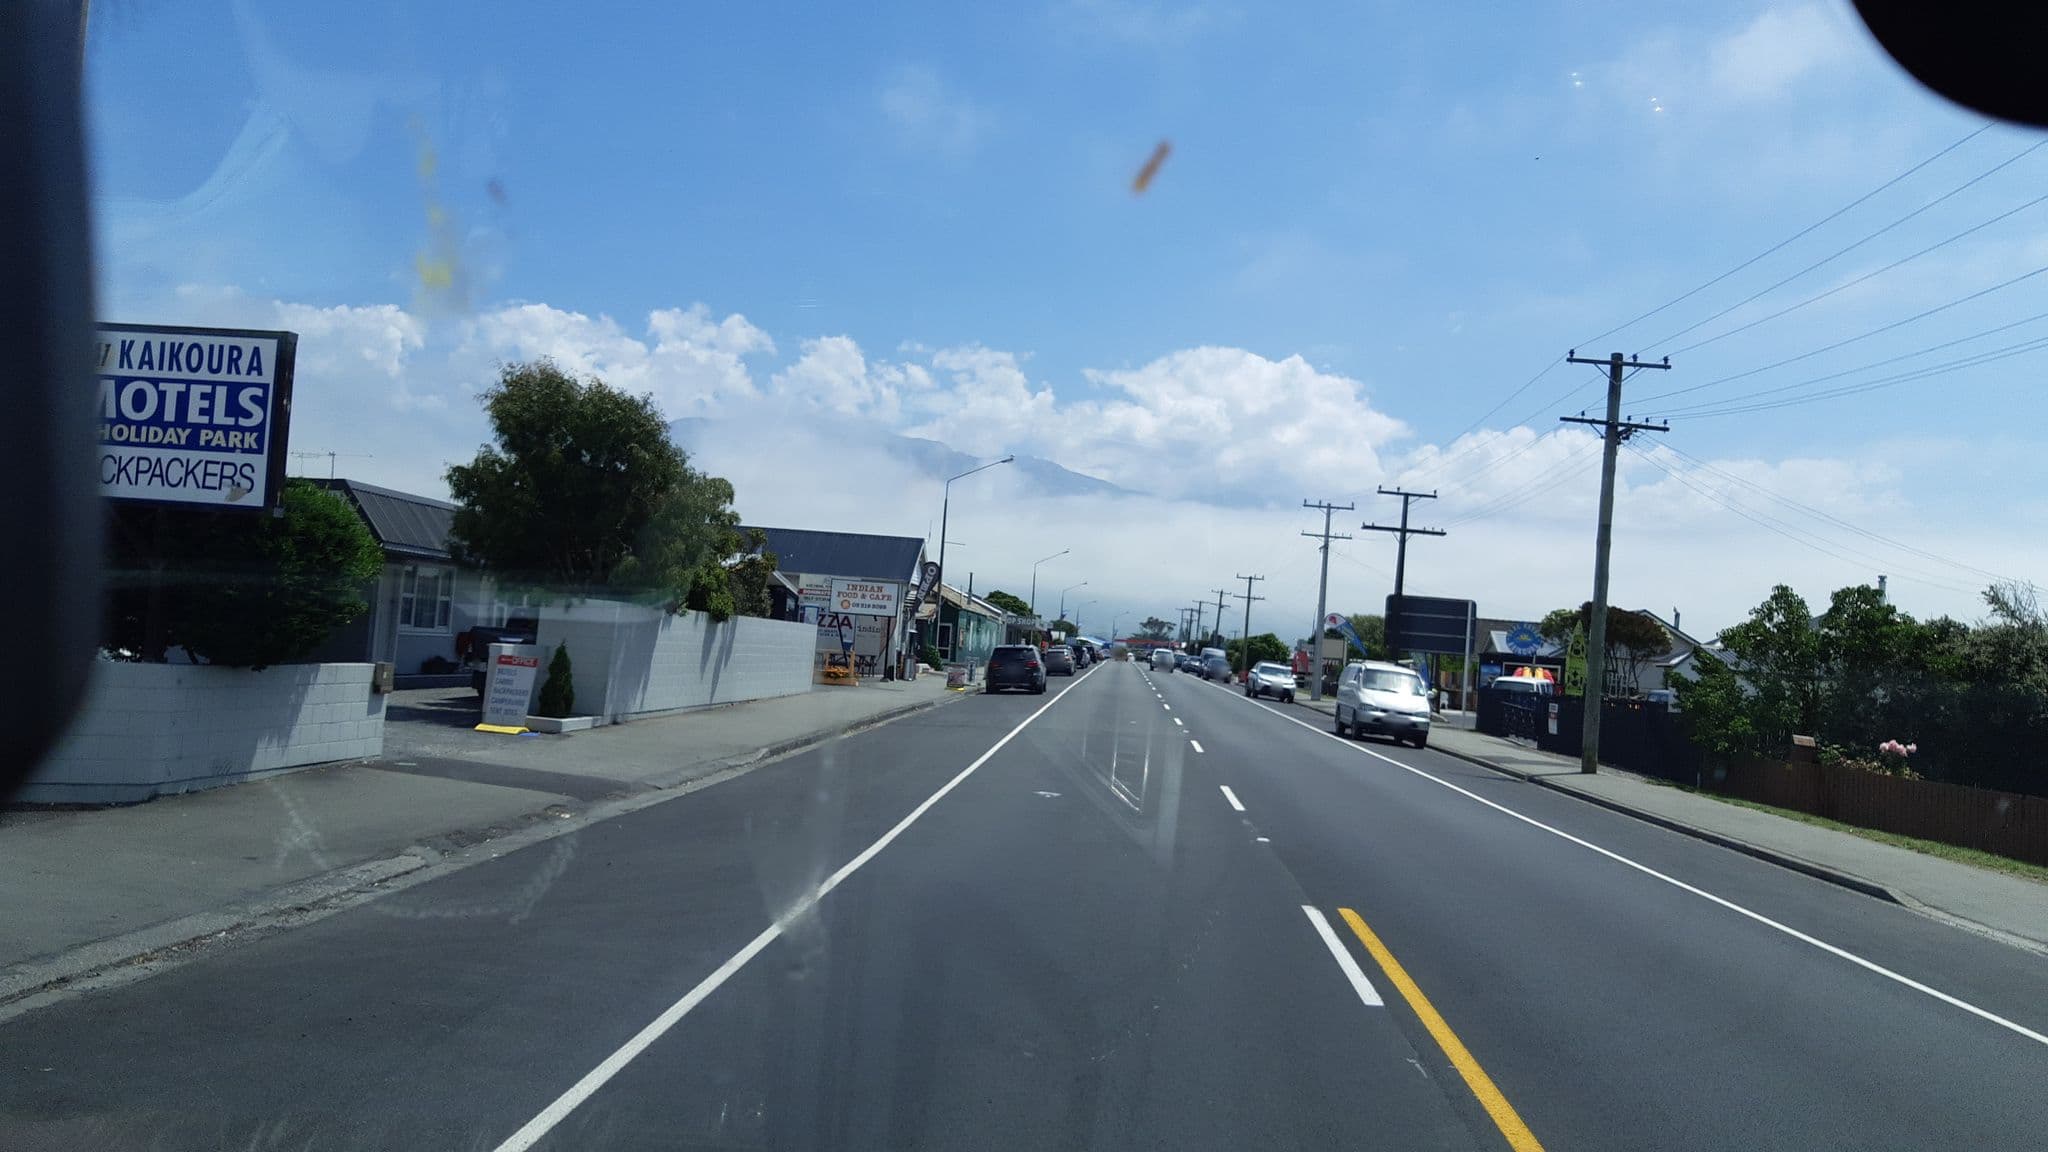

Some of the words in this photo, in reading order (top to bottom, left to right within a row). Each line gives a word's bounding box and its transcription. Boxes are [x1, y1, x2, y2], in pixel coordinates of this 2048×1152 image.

[119, 339, 264, 377] KAIKOURA
[199, 429, 259, 449] PARK
[847, 583, 884, 593] INDIAN
[917, 566, 937, 601] OPEN
[837, 591, 858, 599] FOOD
[869, 593, 893, 602] CAFE
[512, 656, 535, 666] OFFICE
